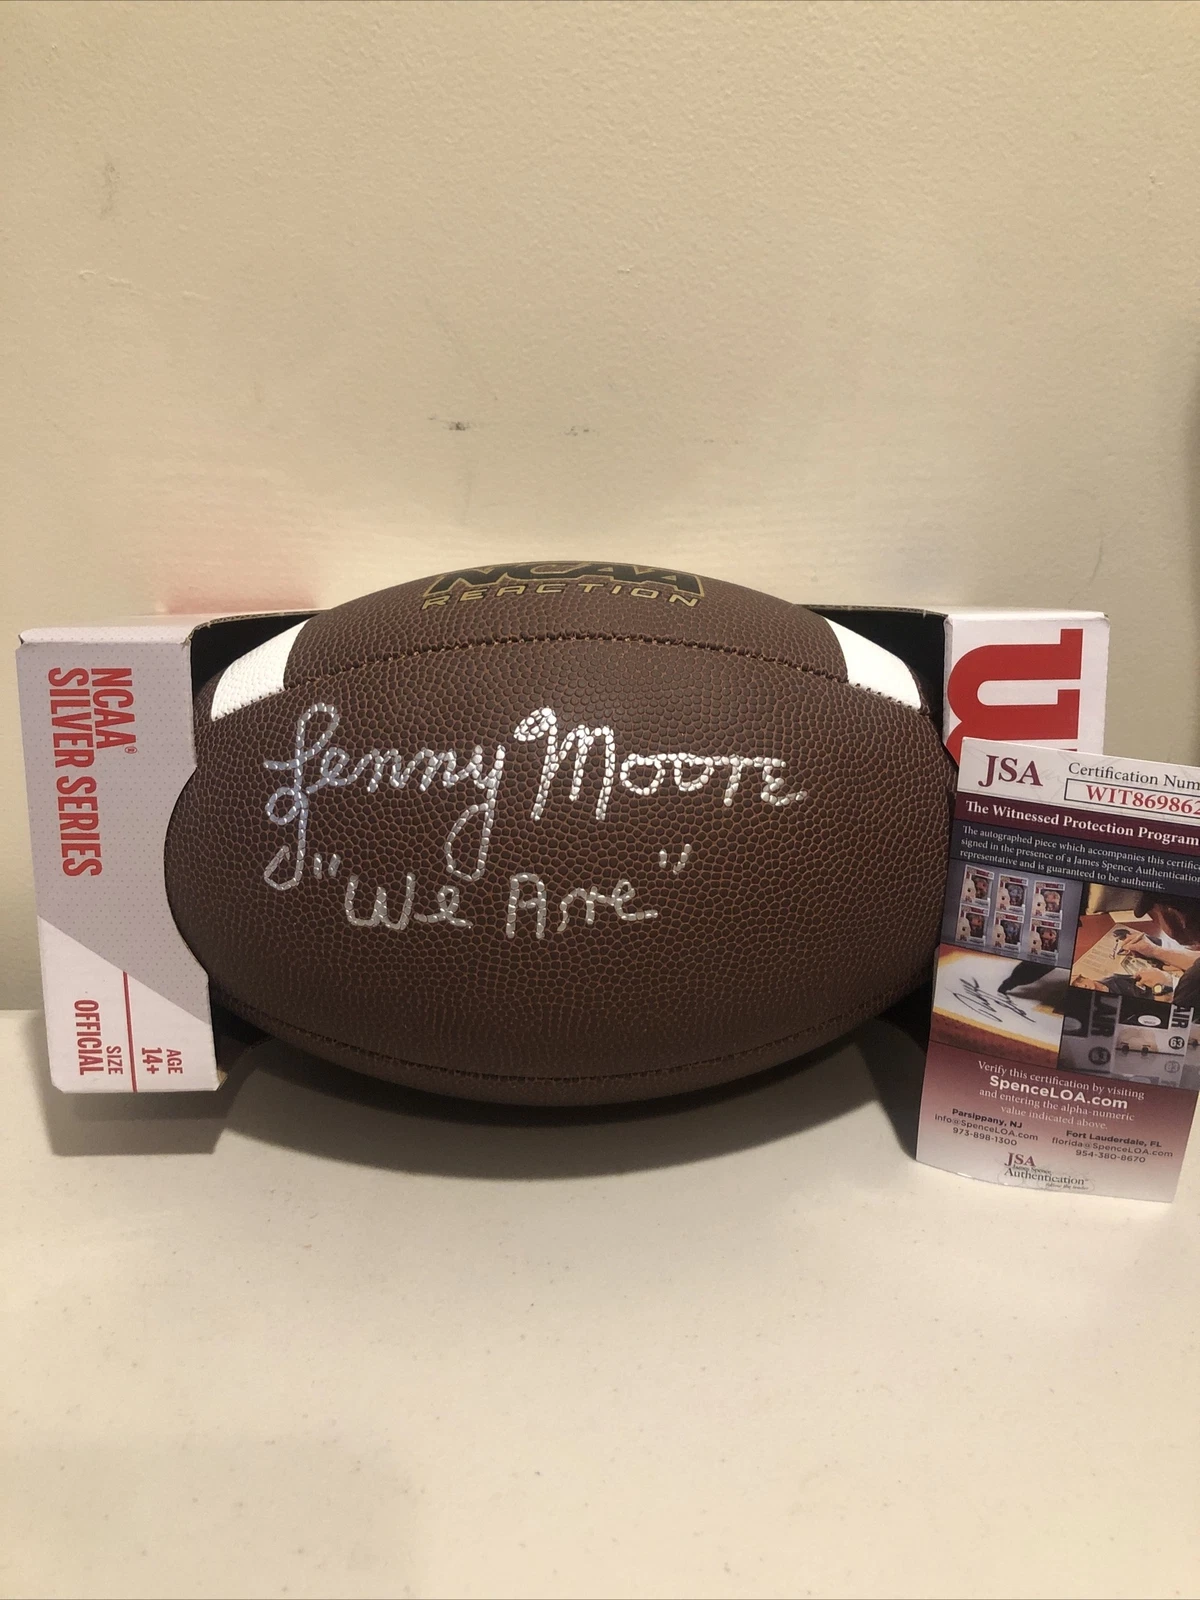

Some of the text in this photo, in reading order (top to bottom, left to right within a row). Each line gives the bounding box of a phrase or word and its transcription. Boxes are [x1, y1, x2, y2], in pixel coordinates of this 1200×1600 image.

[422, 561, 705, 597] NCAA
[422, 583, 699, 610] REACTION
[91, 668, 137, 749] NCAA
[48, 667, 103, 877] SILVER SERIES
[978, 754, 1043, 787] JSA
[1068, 762, 1158, 785] Certification
[264, 702, 808, 891] Lenny Moore
[966, 800, 1200, 846] The Witnessed Protection Program
[961, 838, 988, 849] signed
[990, 842, 999, 851] in
[1001, 843, 1015, 854] the
[1016, 848, 1054, 860] presence
[1055, 853, 1066, 862] of
[1074, 855, 1100, 867] James
[1101, 860, 1134, 872] Spence
[963, 825, 978, 835] The
[980, 829, 1033, 845] autographed
[1034, 838, 1057, 848] piece
[1059, 842, 1085, 853] which
[1087, 847, 1145, 862] accompanies
[1147, 855, 1164, 865] this
[960, 850, 1165, 890] representative and is guaranteed to be authentic.
[74, 999, 104, 1075] OFFICIAL
[106, 1045, 123, 1075] SIZE
[142, 1047, 163, 1075] 14+
[166, 1049, 183, 1074] AGE
[978, 1060, 1145, 1101] Verify this certification by visiting
[989, 1075, 1128, 1109] SpenceLOA.com
[952, 1108, 1023, 1129] Parsippany, NJ
[979, 1088, 1135, 1121] and entering the alpha-numeric
[1000, 1105, 1107, 1130] value indicated above.
[953, 1127, 1017, 1146] 973-898-1300
[1066, 1129, 1162, 1148] Fort Lauderdale, FL
[1004, 1152, 1036, 1167] JSA
[1075, 1149, 1146, 1163] 954-380-8670
